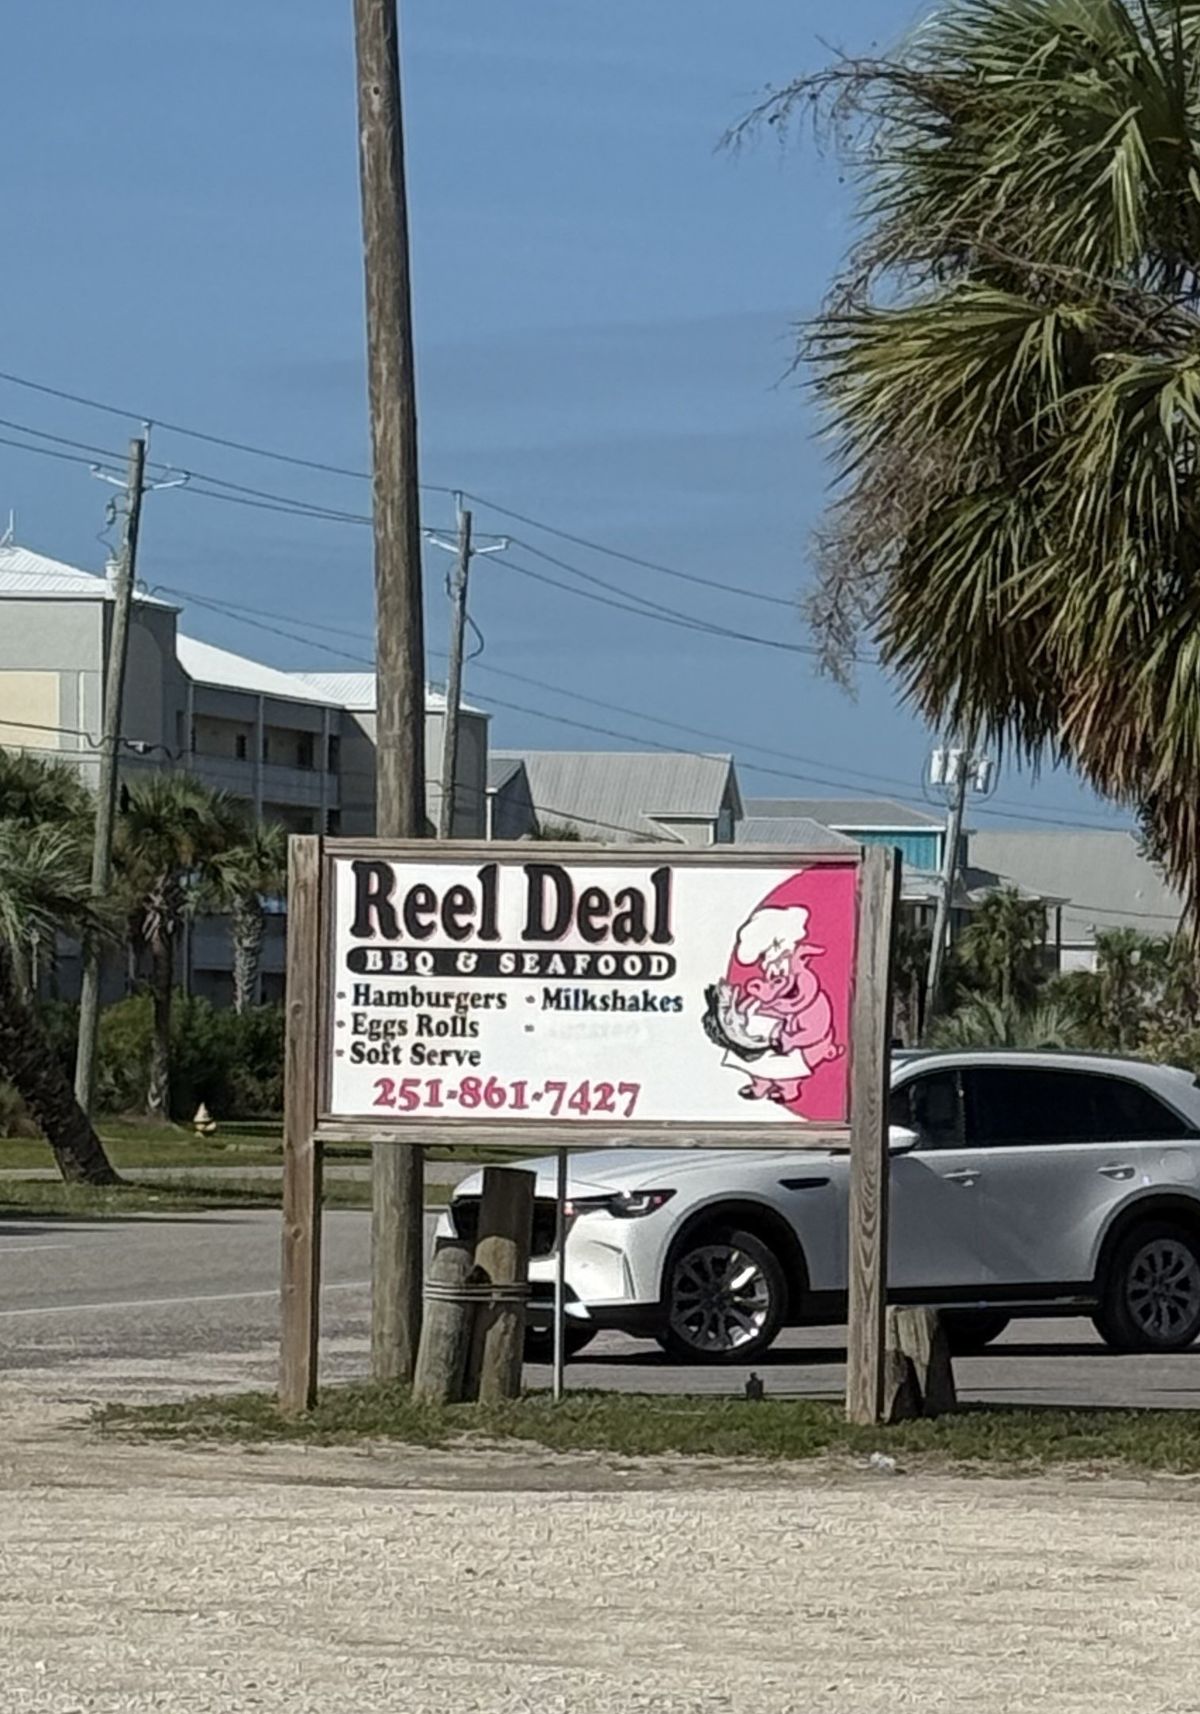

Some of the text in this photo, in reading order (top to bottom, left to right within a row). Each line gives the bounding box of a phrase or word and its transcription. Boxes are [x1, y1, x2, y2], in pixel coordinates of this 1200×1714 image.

[350, 860, 675, 945] Reel Deal
[365, 950, 670, 977] BBQ & SEAFOOD
[351, 983, 507, 1014] Hamburgers
[540, 988, 684, 1013] Milkshakes
[351, 1012, 481, 1042] Eggs Rolls
[350, 1041, 482, 1068] Soft Serve
[372, 1076, 642, 1118] 251-861-7427
